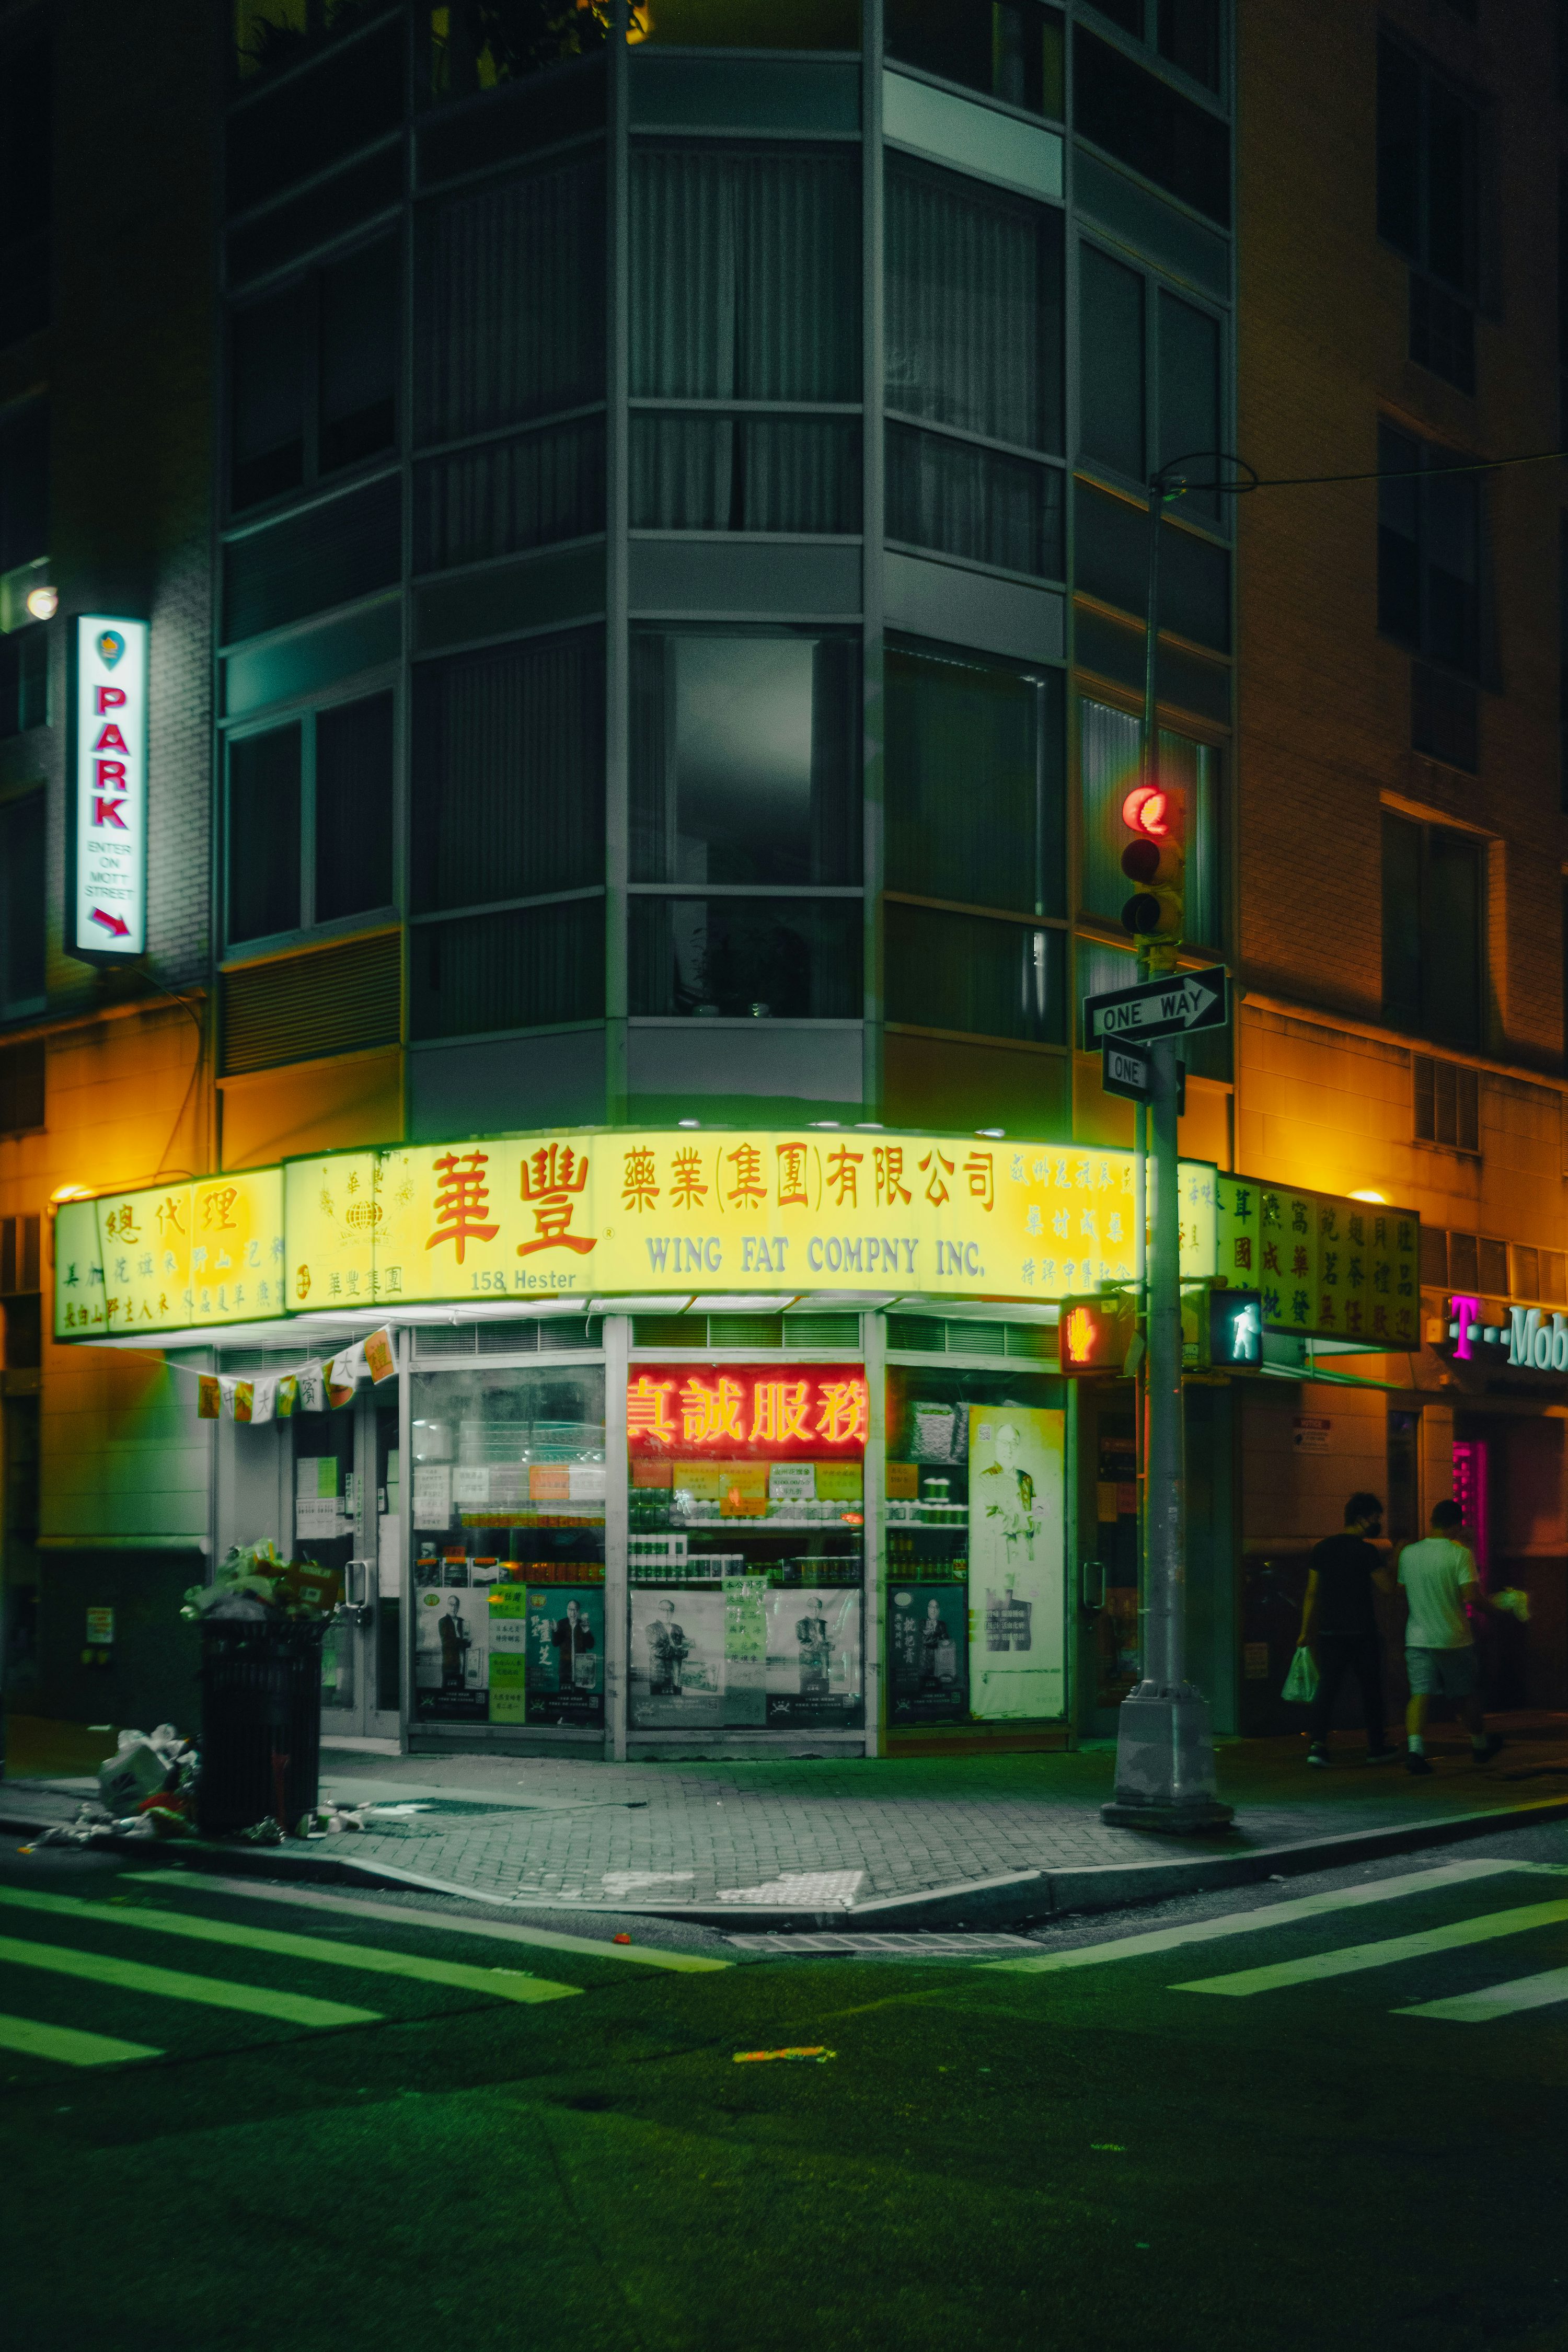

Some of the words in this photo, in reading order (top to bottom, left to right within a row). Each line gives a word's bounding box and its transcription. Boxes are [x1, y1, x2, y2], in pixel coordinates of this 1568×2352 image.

[94, 685, 131, 830] PARK
[87, 840, 132, 856] ENTER
[99, 856, 120, 869] ON
[85, 885, 134, 900] STREET
[90, 871, 130, 885] MOTT
[1103, 1002, 1142, 1030] ONE
[1161, 989, 1202, 1018] WAY
[1114, 1056, 1138, 1084] ONE
[621, 1142, 994, 1213] 藥業(集團)有限公司
[105, 1187, 238, 1244] 總代理
[425, 1143, 597, 1264] 華豐
[645, 1237, 722, 1273] WING
[741, 1237, 788, 1273] FAT
[807, 1237, 918, 1274] COMPNY
[936, 1240, 984, 1277] INC.
[471, 1271, 504, 1291] 158
[514, 1270, 576, 1289] Hester
[627, 1377, 866, 1443] 真誠服務
